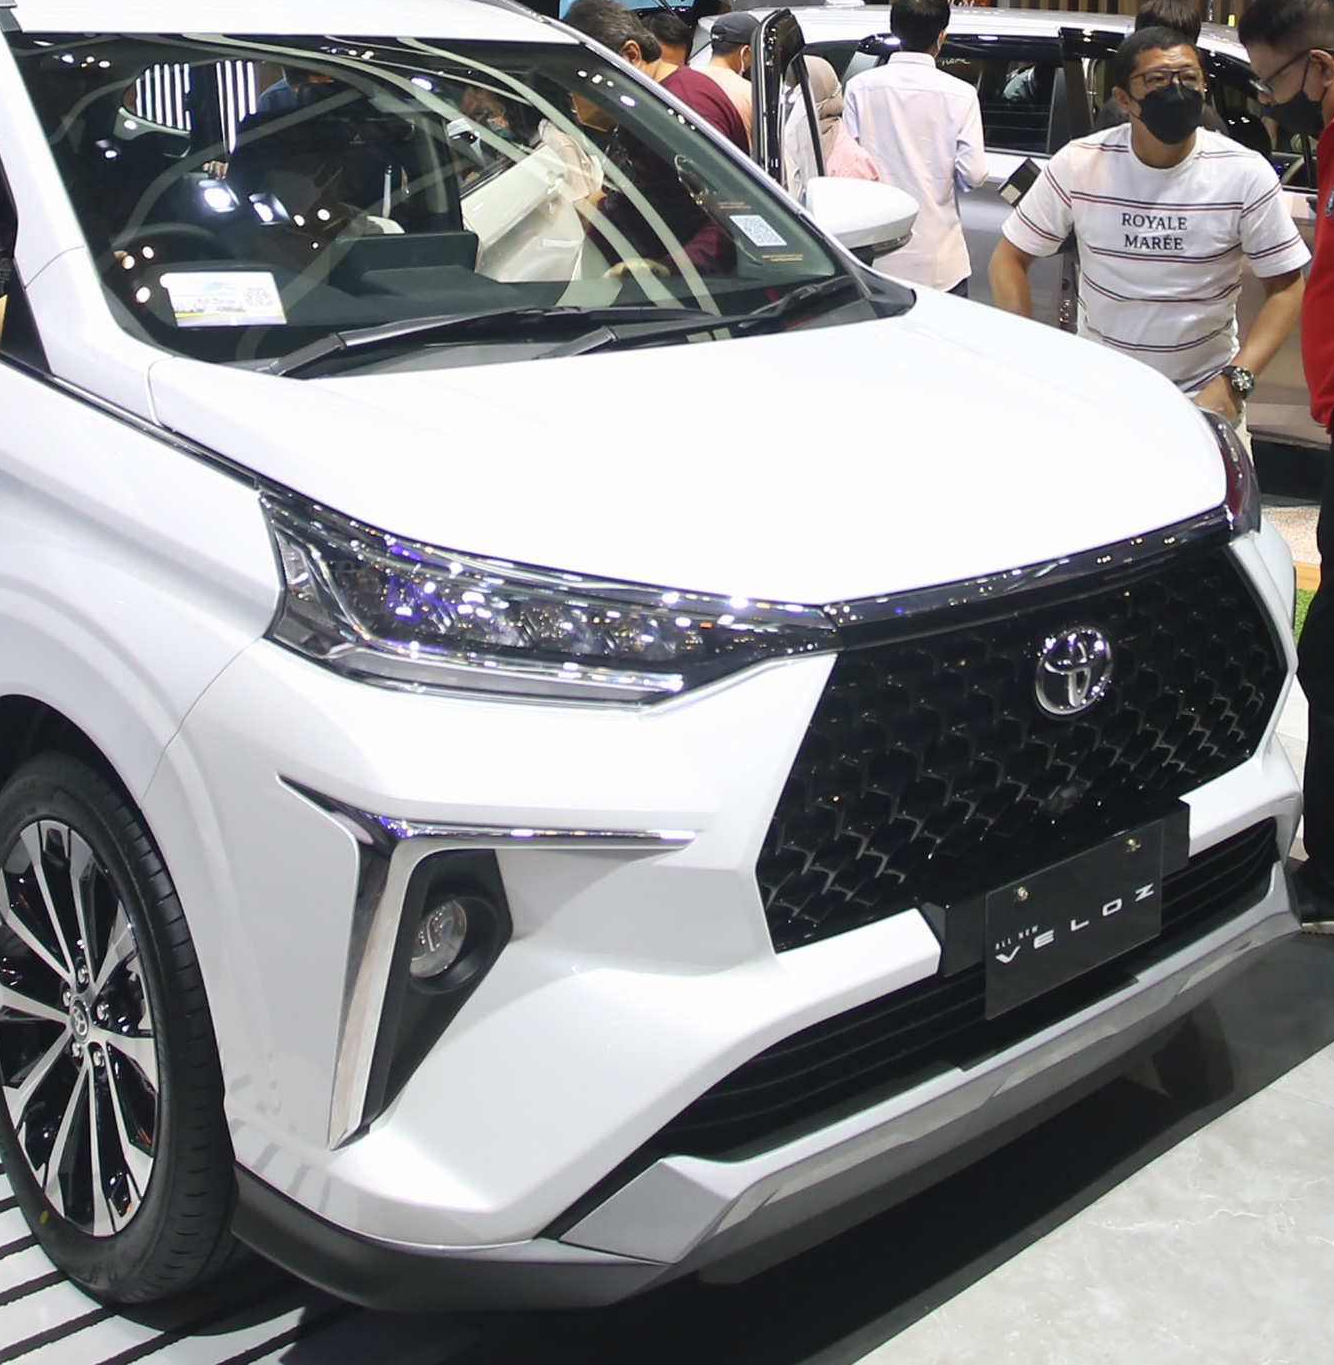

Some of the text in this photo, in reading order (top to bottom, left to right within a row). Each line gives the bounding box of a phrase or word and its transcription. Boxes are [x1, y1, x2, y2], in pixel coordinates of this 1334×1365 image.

[1121, 213, 1187, 231] ROYALE
[995, 883, 1154, 964] VELOZ
[995, 925, 1038, 950] ALL NEW
